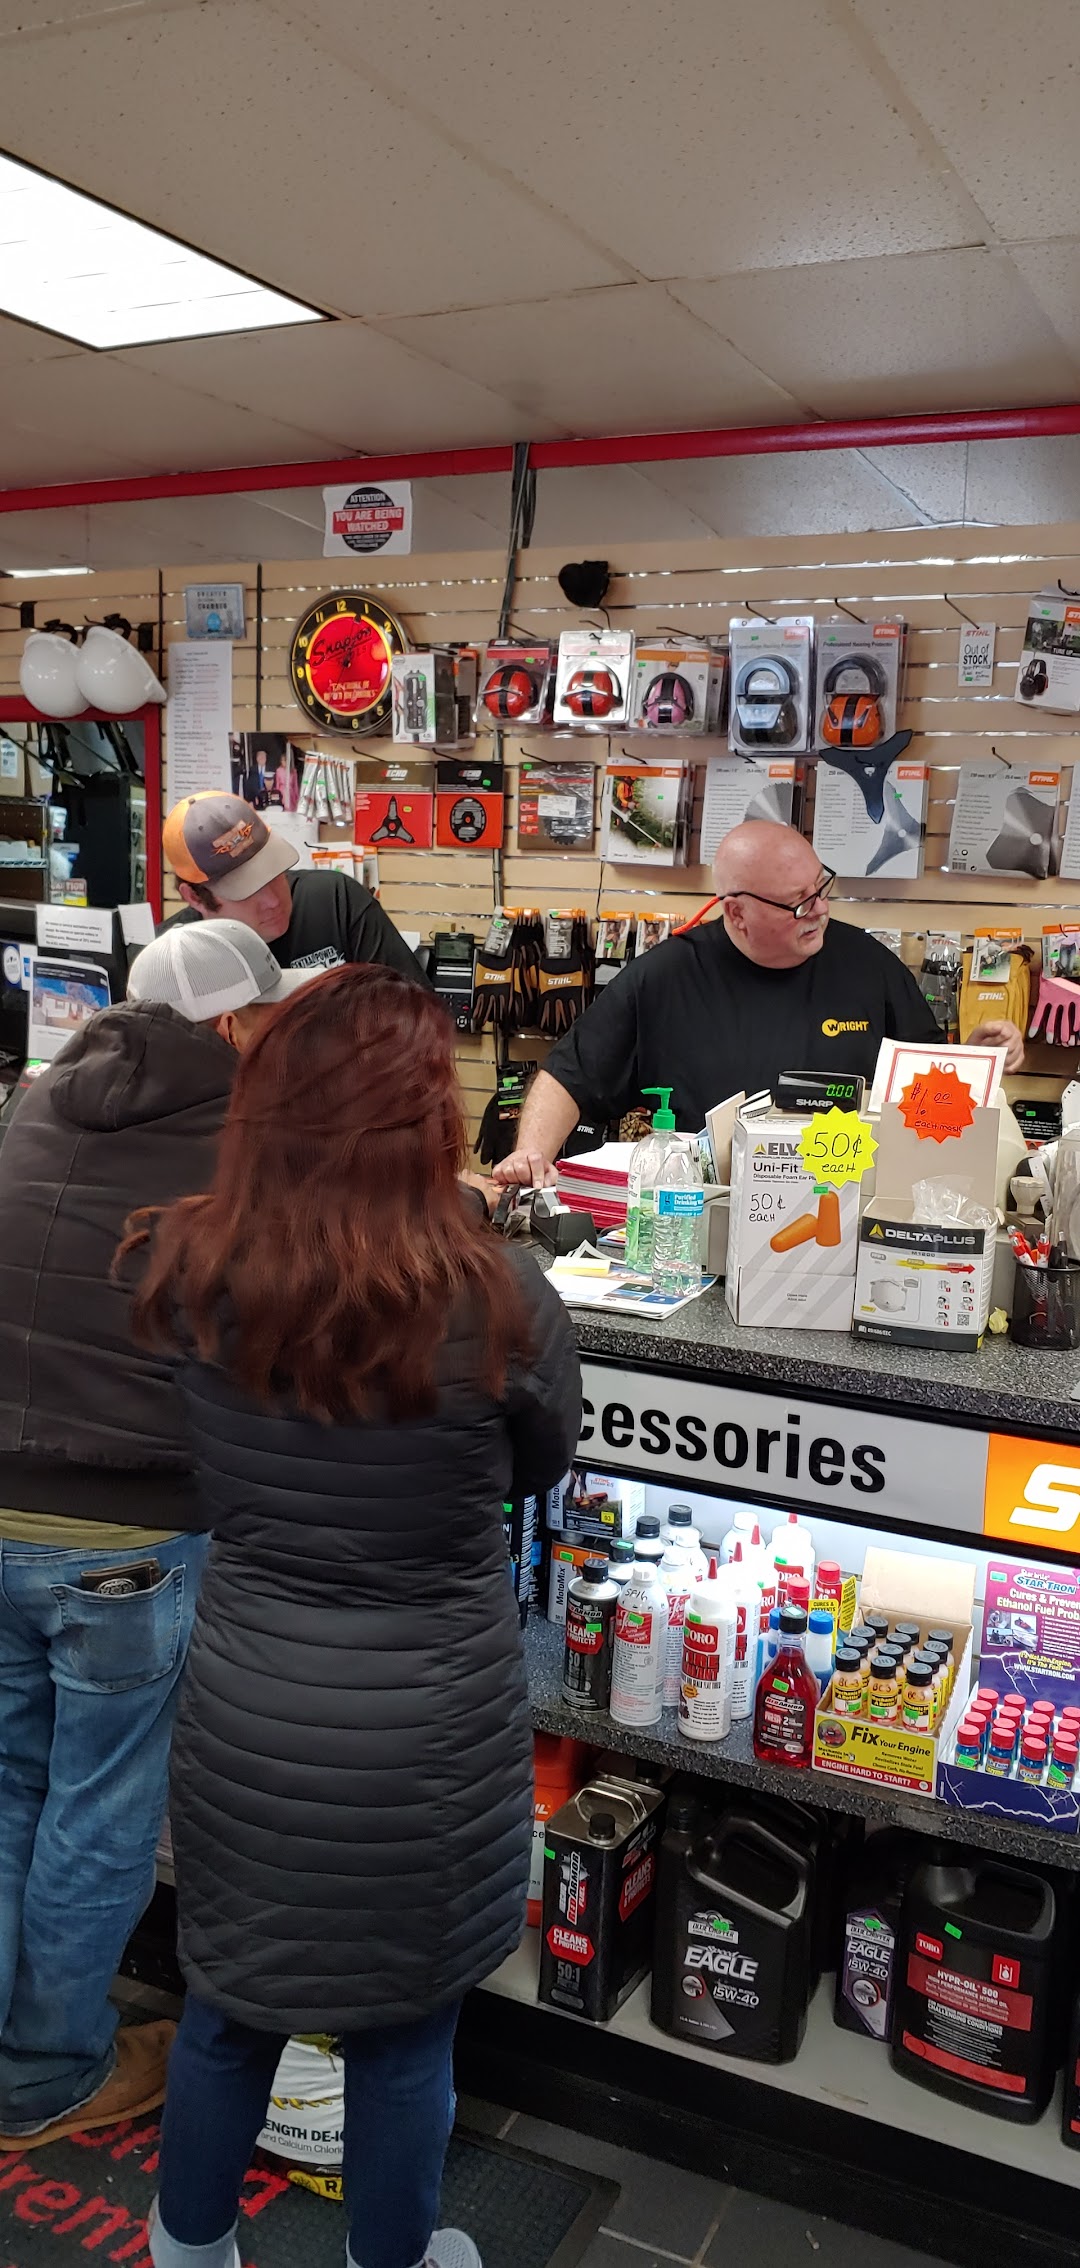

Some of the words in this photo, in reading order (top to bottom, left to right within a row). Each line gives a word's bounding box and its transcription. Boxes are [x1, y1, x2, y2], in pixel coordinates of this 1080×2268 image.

[350, 493, 385, 503] ATTENTION
[335, 512, 352, 522] YOU
[355, 510, 373, 520] ARE
[374, 508, 402, 519] BEING
[347, 520, 389, 532] WATCHED
[336, 600, 347, 612] 12
[364, 604, 369, 614] 1
[315, 612, 324, 622] 11
[384, 622, 392, 633] 2
[298, 637, 308, 648] 10
[964, 644, 979, 655] Out
[981, 643, 990, 655] of
[963, 654, 989, 665] STOCK
[297, 667, 304, 678] 9
[307, 695, 314, 705] 8
[377, 705, 384, 716] 5
[325, 713, 332, 723] 7
[352, 718, 359, 729] 6
[385, 769, 408, 778] ECHO
[462, 769, 482, 778] ECHO
[898, 769, 921, 777] STIHL
[1030, 775, 1054, 783] STIHL
[484, 972, 506, 981] STIHL
[547, 977, 572, 985] STIHL
[978, 992, 1005, 1001] STIHL
[824, 1019, 869, 1034] WRIGHT
[826, 1084, 854, 1097] 0.00
[796, 1098, 834, 1107] SHARP
[576, 1125, 595, 1134] STIHL
[753, 1162, 799, 1174] Uni-Fit
[750, 1193, 773, 1212] 50
[885, 1228, 976, 1245] DELTAPLUS
[555, 1567, 566, 1606] MotoMix
[1017, 1577, 1044, 1588] STAR
[1047, 1581, 1076, 1594] TRON
[1010, 1588, 1037, 1602] Cures
[1039, 1594, 1047, 1603] &
[997, 1597, 1032, 1612] Ethanol
[1035, 1603, 1055, 1616] Fuel
[688, 1630, 715, 1645] ORO
[1013, 1663, 1076, 1681] WWW.STARTRON.COM
[851, 1726, 880, 1746] Fix
[880, 1740, 896, 1749] Your
[898, 1742, 931, 1756] Engine
[822, 1760, 849, 1772] ENGINE
[850, 1766, 871, 1777] HARD
[884, 1774, 911, 1786] START?
[625, 1857, 651, 1896] CLEANS
[566, 1851, 581, 1926] REDARMOR
[553, 1928, 588, 1948] CLEANS
[558, 1941, 588, 1955] PROTECTS
[847, 1940, 890, 1963] EAGLE
[918, 1938, 940, 1954] TORO
[684, 1946, 759, 1982] EAGLE
[848, 1959, 889, 1978] 15W-40
[557, 1960, 581, 1983] 50:1
[928, 1974, 940, 1984] HIGH
[940, 1980, 978, 1999] PERFORMANCE
[980, 1993, 998, 2006] HYDRO
[999, 2000, 1008, 2008] OIL
[937, 1969, 978, 1992] HYPR-OIL
[982, 1986, 998, 1999] 500
[713, 1985, 760, 2006] 15W-40
[928, 2003, 966, 2023] CHALLENGING
[967, 2017, 1003, 2036] CONDITIONS
[278, 2136, 312, 2152] Calcium
